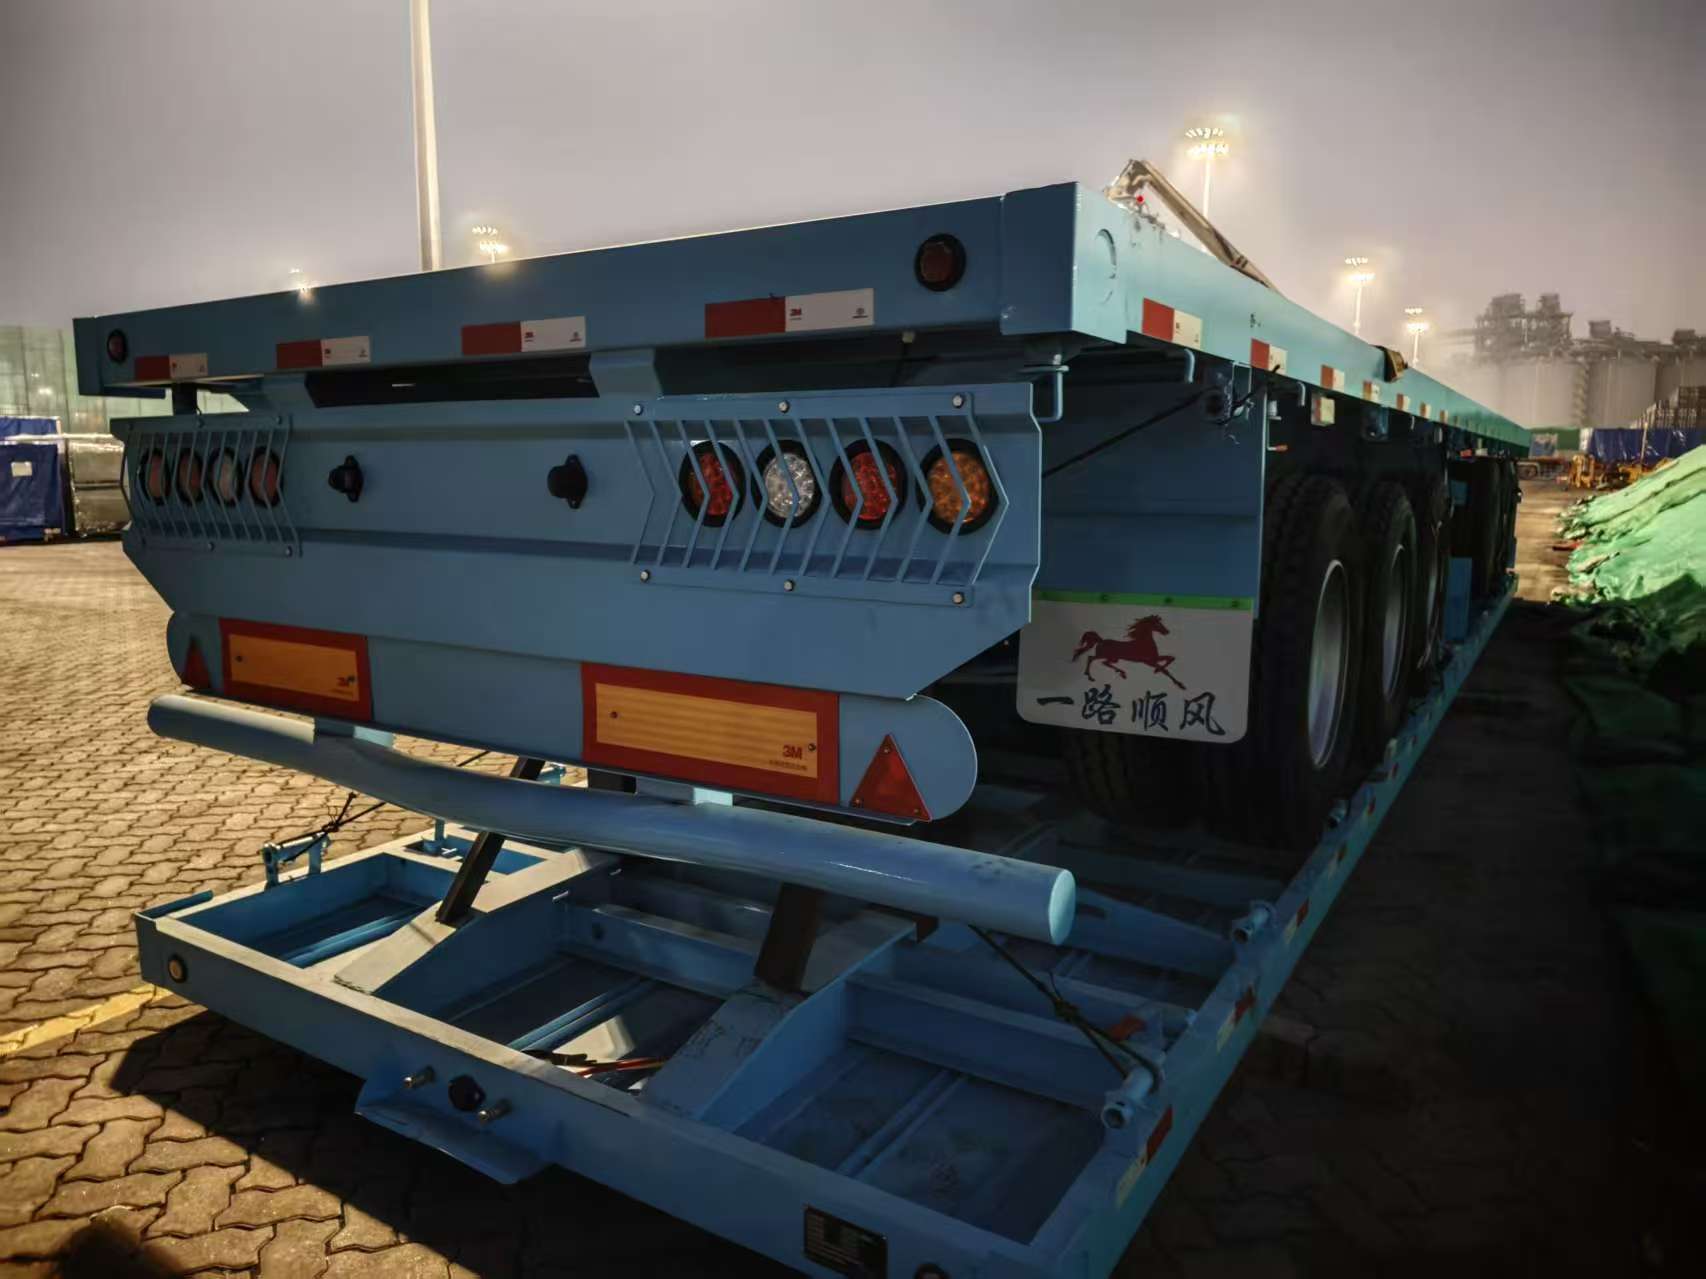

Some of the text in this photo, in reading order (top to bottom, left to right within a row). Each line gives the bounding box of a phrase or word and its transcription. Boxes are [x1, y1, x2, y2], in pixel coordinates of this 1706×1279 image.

[1037, 684, 1226, 735] 一路顺风
[783, 744, 803, 760] 3M
